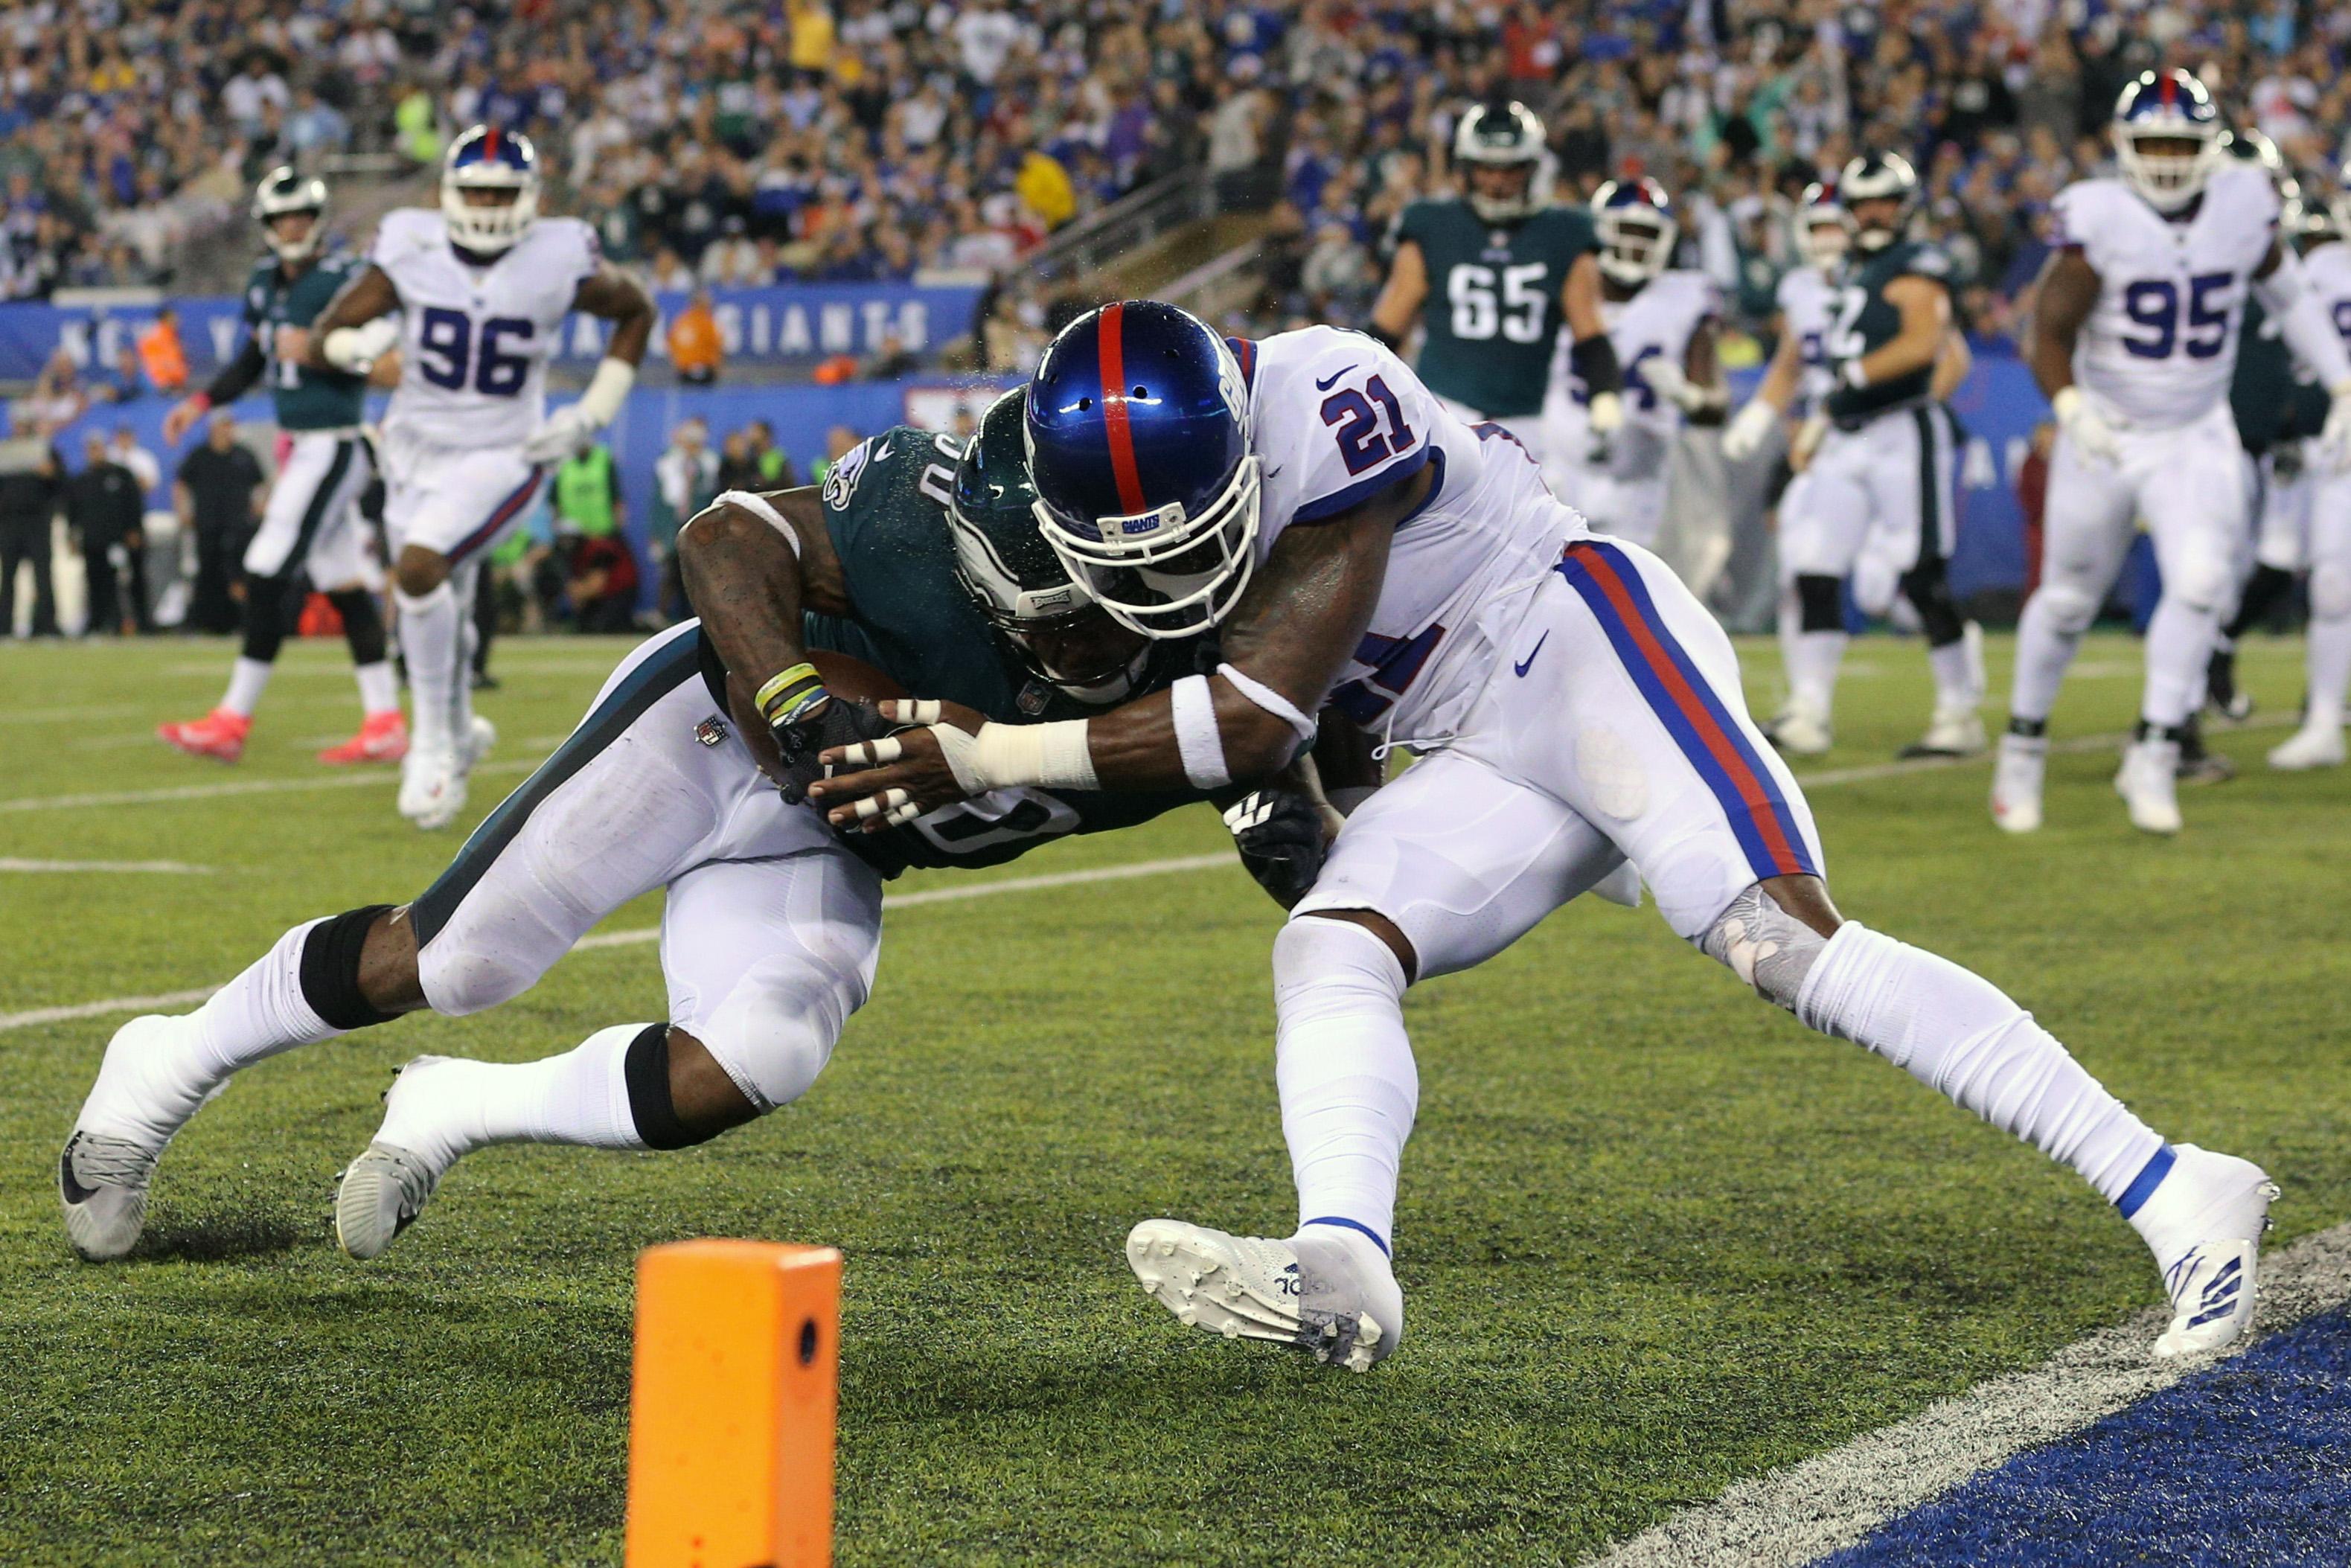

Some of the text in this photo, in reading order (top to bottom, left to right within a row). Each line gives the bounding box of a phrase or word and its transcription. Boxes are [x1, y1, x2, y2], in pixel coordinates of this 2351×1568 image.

[714, 301, 928, 355] GIANTS
[1448, 262, 1548, 345] 65
[2123, 272, 2235, 360] 95
[420, 307, 536, 396] 96
[1320, 374, 1416, 476] 21
[1122, 513, 1159, 534] GIANTS
